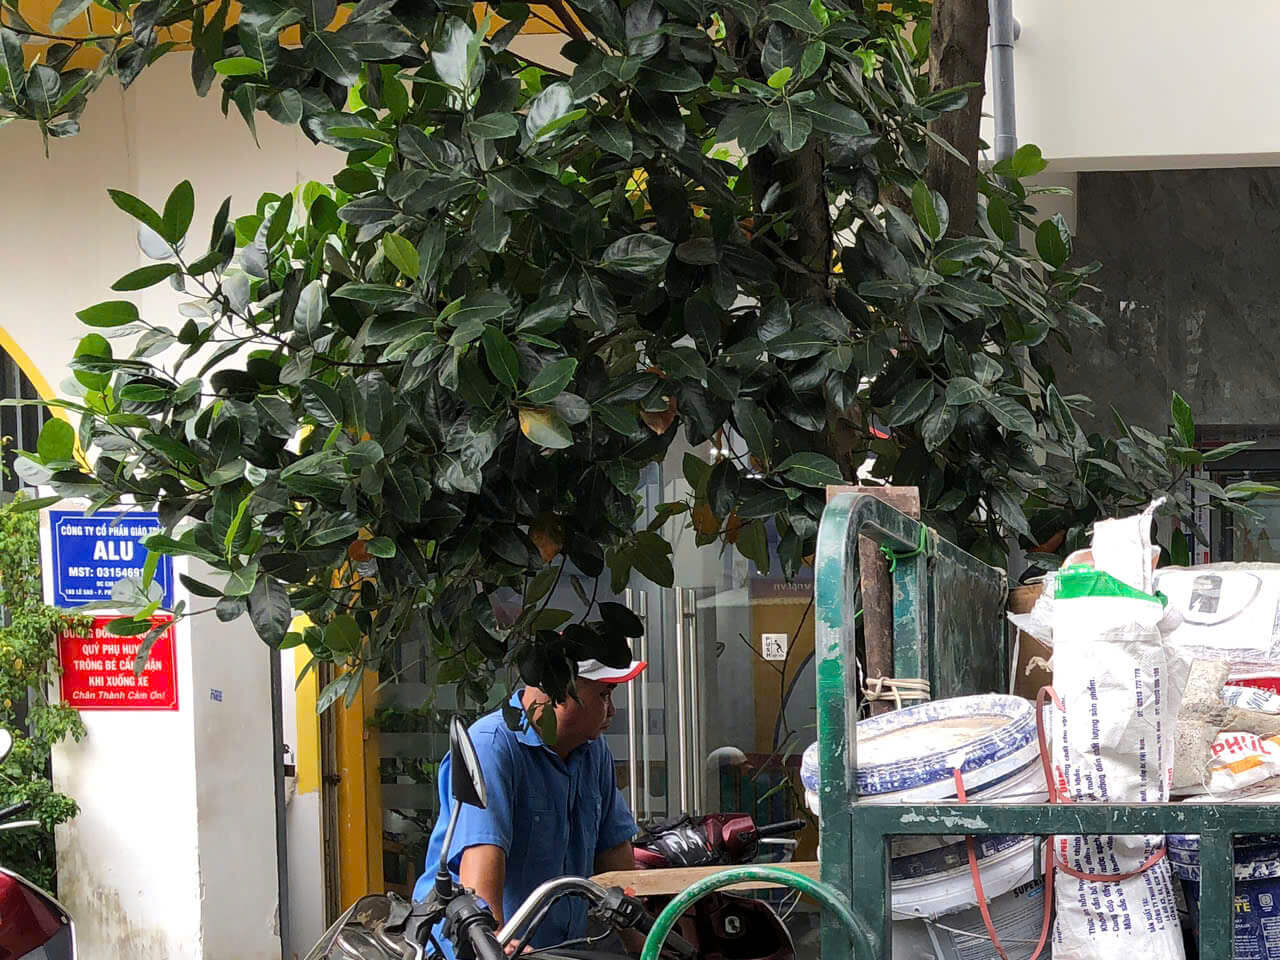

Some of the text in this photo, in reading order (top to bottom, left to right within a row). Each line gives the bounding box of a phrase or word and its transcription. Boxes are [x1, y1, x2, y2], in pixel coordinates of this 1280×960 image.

[84, 526, 94, 537] TY
[93, 540, 134, 561] ALU
[68, 566, 157, 578] MST: 03154691
[102, 645, 119, 657] PHỤ
[122, 644, 152, 655] HUY
[144, 659, 162, 673] HẬN
[89, 676, 104, 687] KHI
[138, 676, 149, 687] XE
[98, 691, 126, 700] Thành
